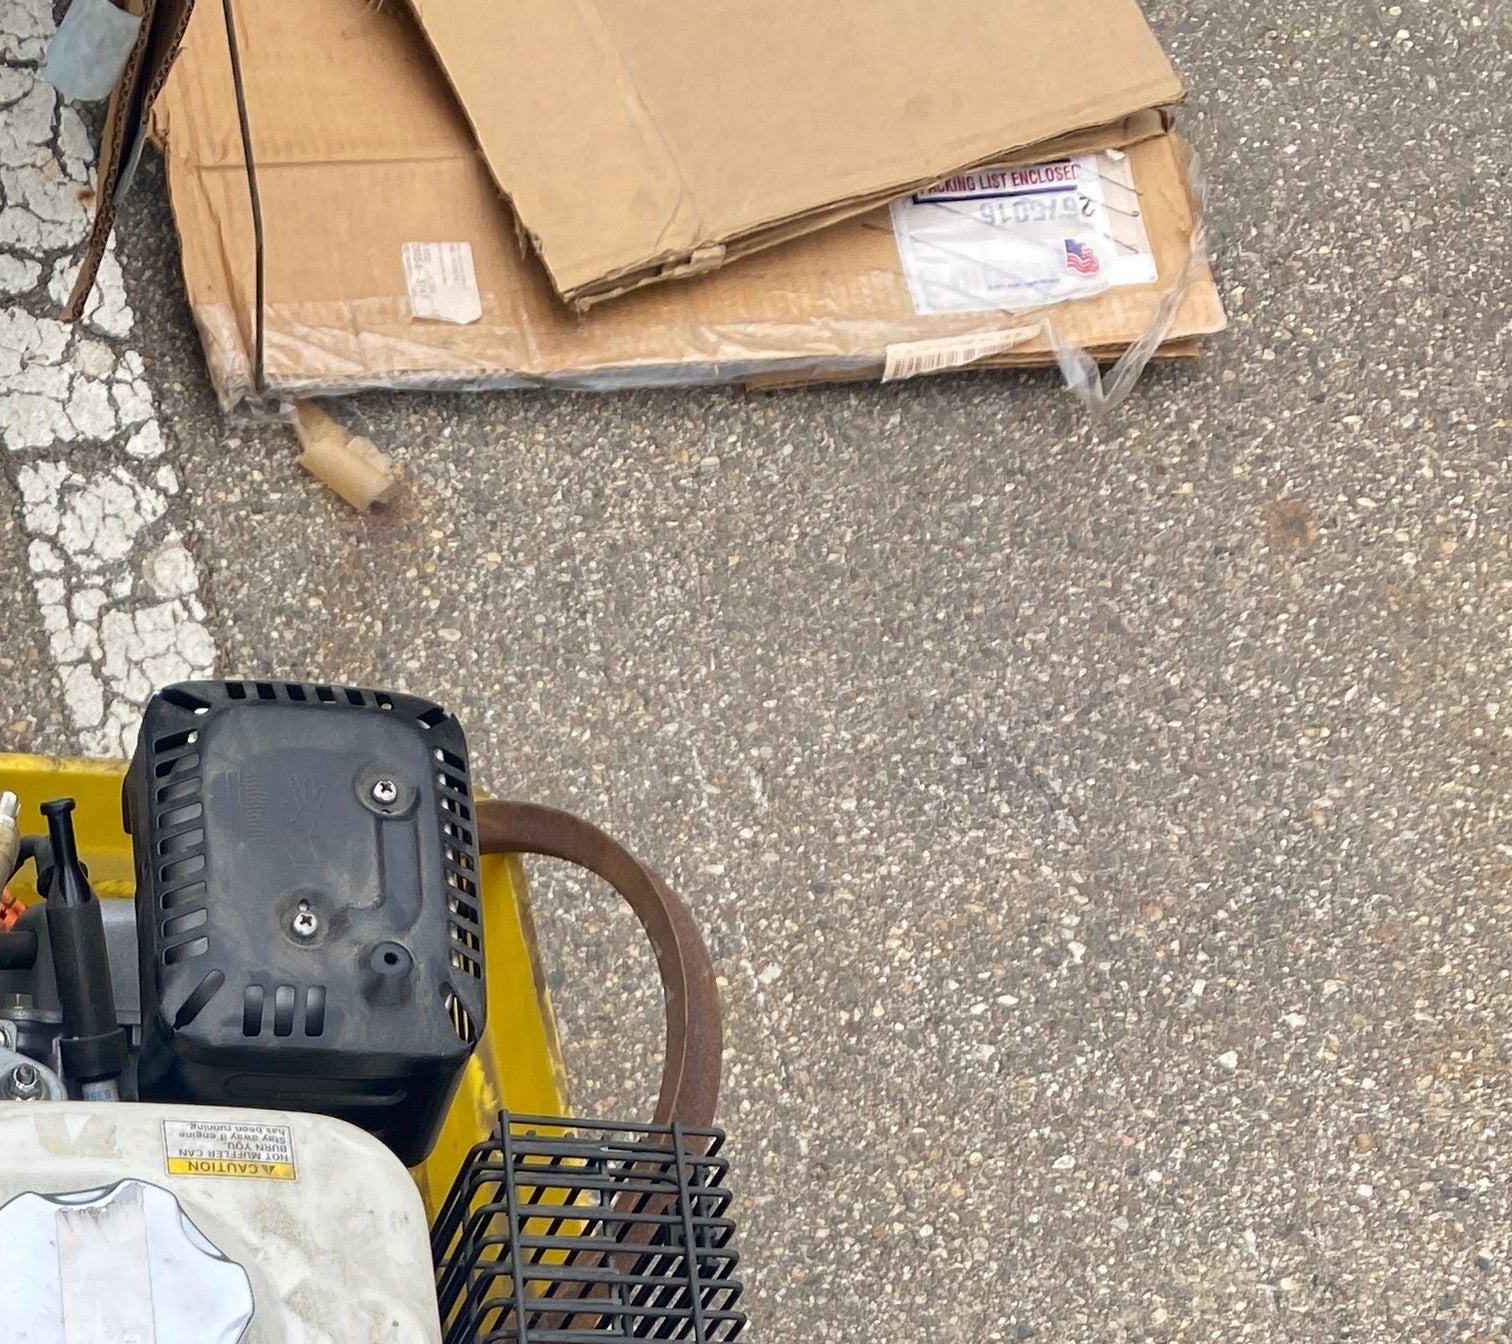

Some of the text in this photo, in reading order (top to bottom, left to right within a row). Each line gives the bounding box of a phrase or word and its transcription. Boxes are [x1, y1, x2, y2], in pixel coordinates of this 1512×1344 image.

[920, 175, 975, 194] ACKING
[979, 172, 1006, 189] LIST
[178, 1129, 216, 1139] engine
[234, 1125, 262, 1133] been
[265, 1127, 285, 1135] has
[230, 1132, 258, 1141] away
[261, 1133, 286, 1144] Stay
[255, 1143, 287, 1152] BURN
[178, 1147, 288, 1161] HOT MUFFLER CAN
[186, 1160, 258, 1174] CAUTION
